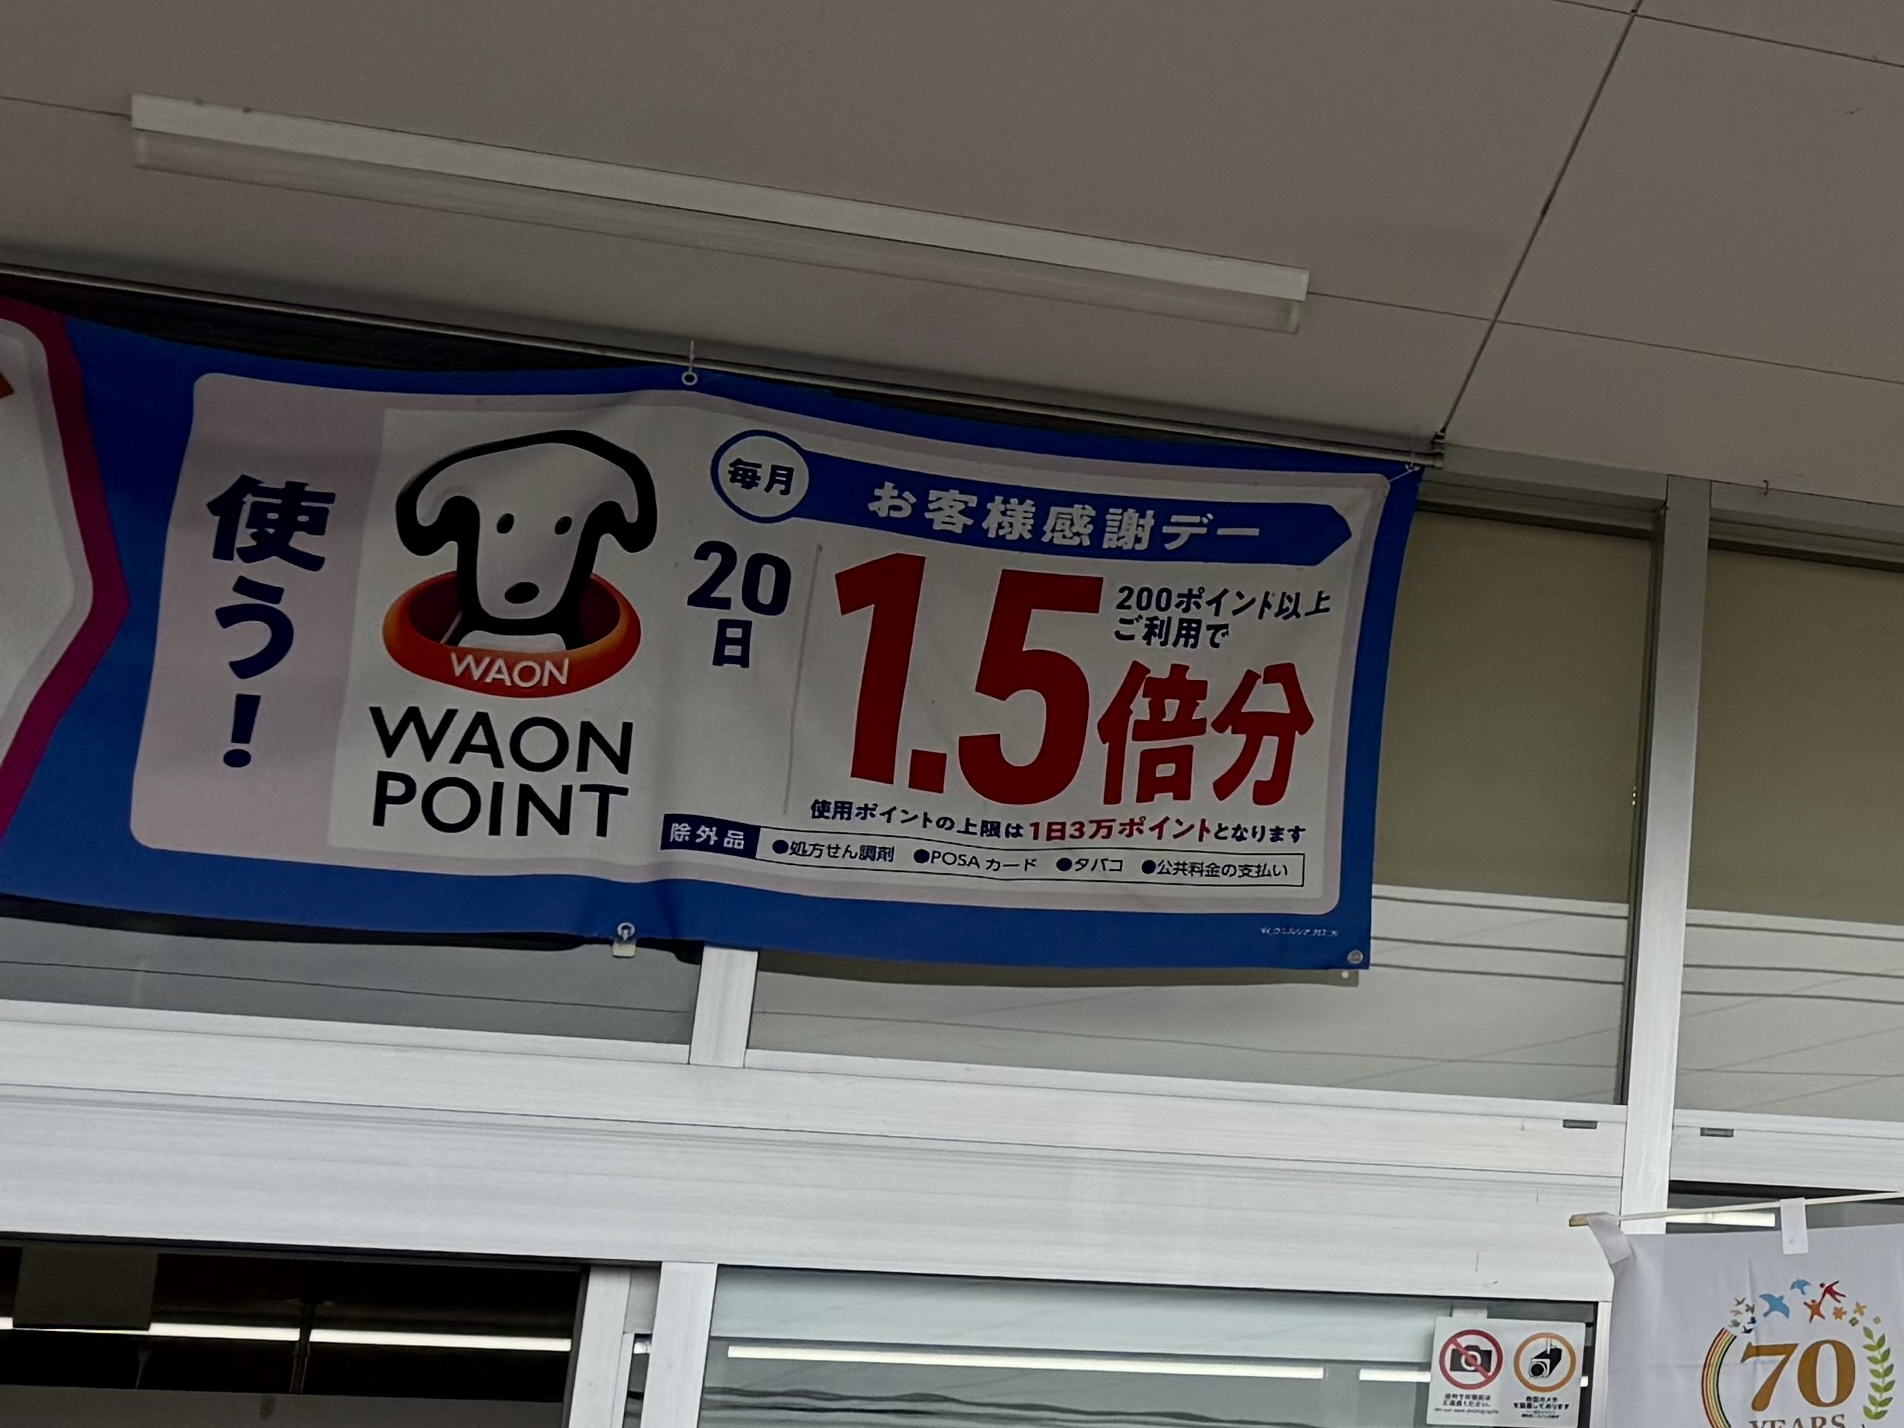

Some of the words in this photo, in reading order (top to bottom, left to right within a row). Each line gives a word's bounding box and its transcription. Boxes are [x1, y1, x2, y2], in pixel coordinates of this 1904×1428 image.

[727, 457, 796, 496] 毎月
[867, 481, 1262, 551] お客様感謝デー
[206, 474, 336, 769] 使う!
[1115, 585, 1333, 621] 200ポイント以上
[1113, 615, 1230, 649] ご利用で
[450, 652, 569, 688] WAON
[369, 705, 634, 775] WAON
[373, 770, 629, 838] POINT
[809, 798, 1308, 845] 使用ポイントの上限は1日3万ポイントとなります
[668, 821, 747, 850] 除外品
[788, 838, 895, 864] 処方せん調剤
[930, 850, 983, 872] POSA
[986, 858, 1038, 873] カード
[1073, 857, 1124, 873] タバコ
[1740, 1339, 1856, 1413] 70
